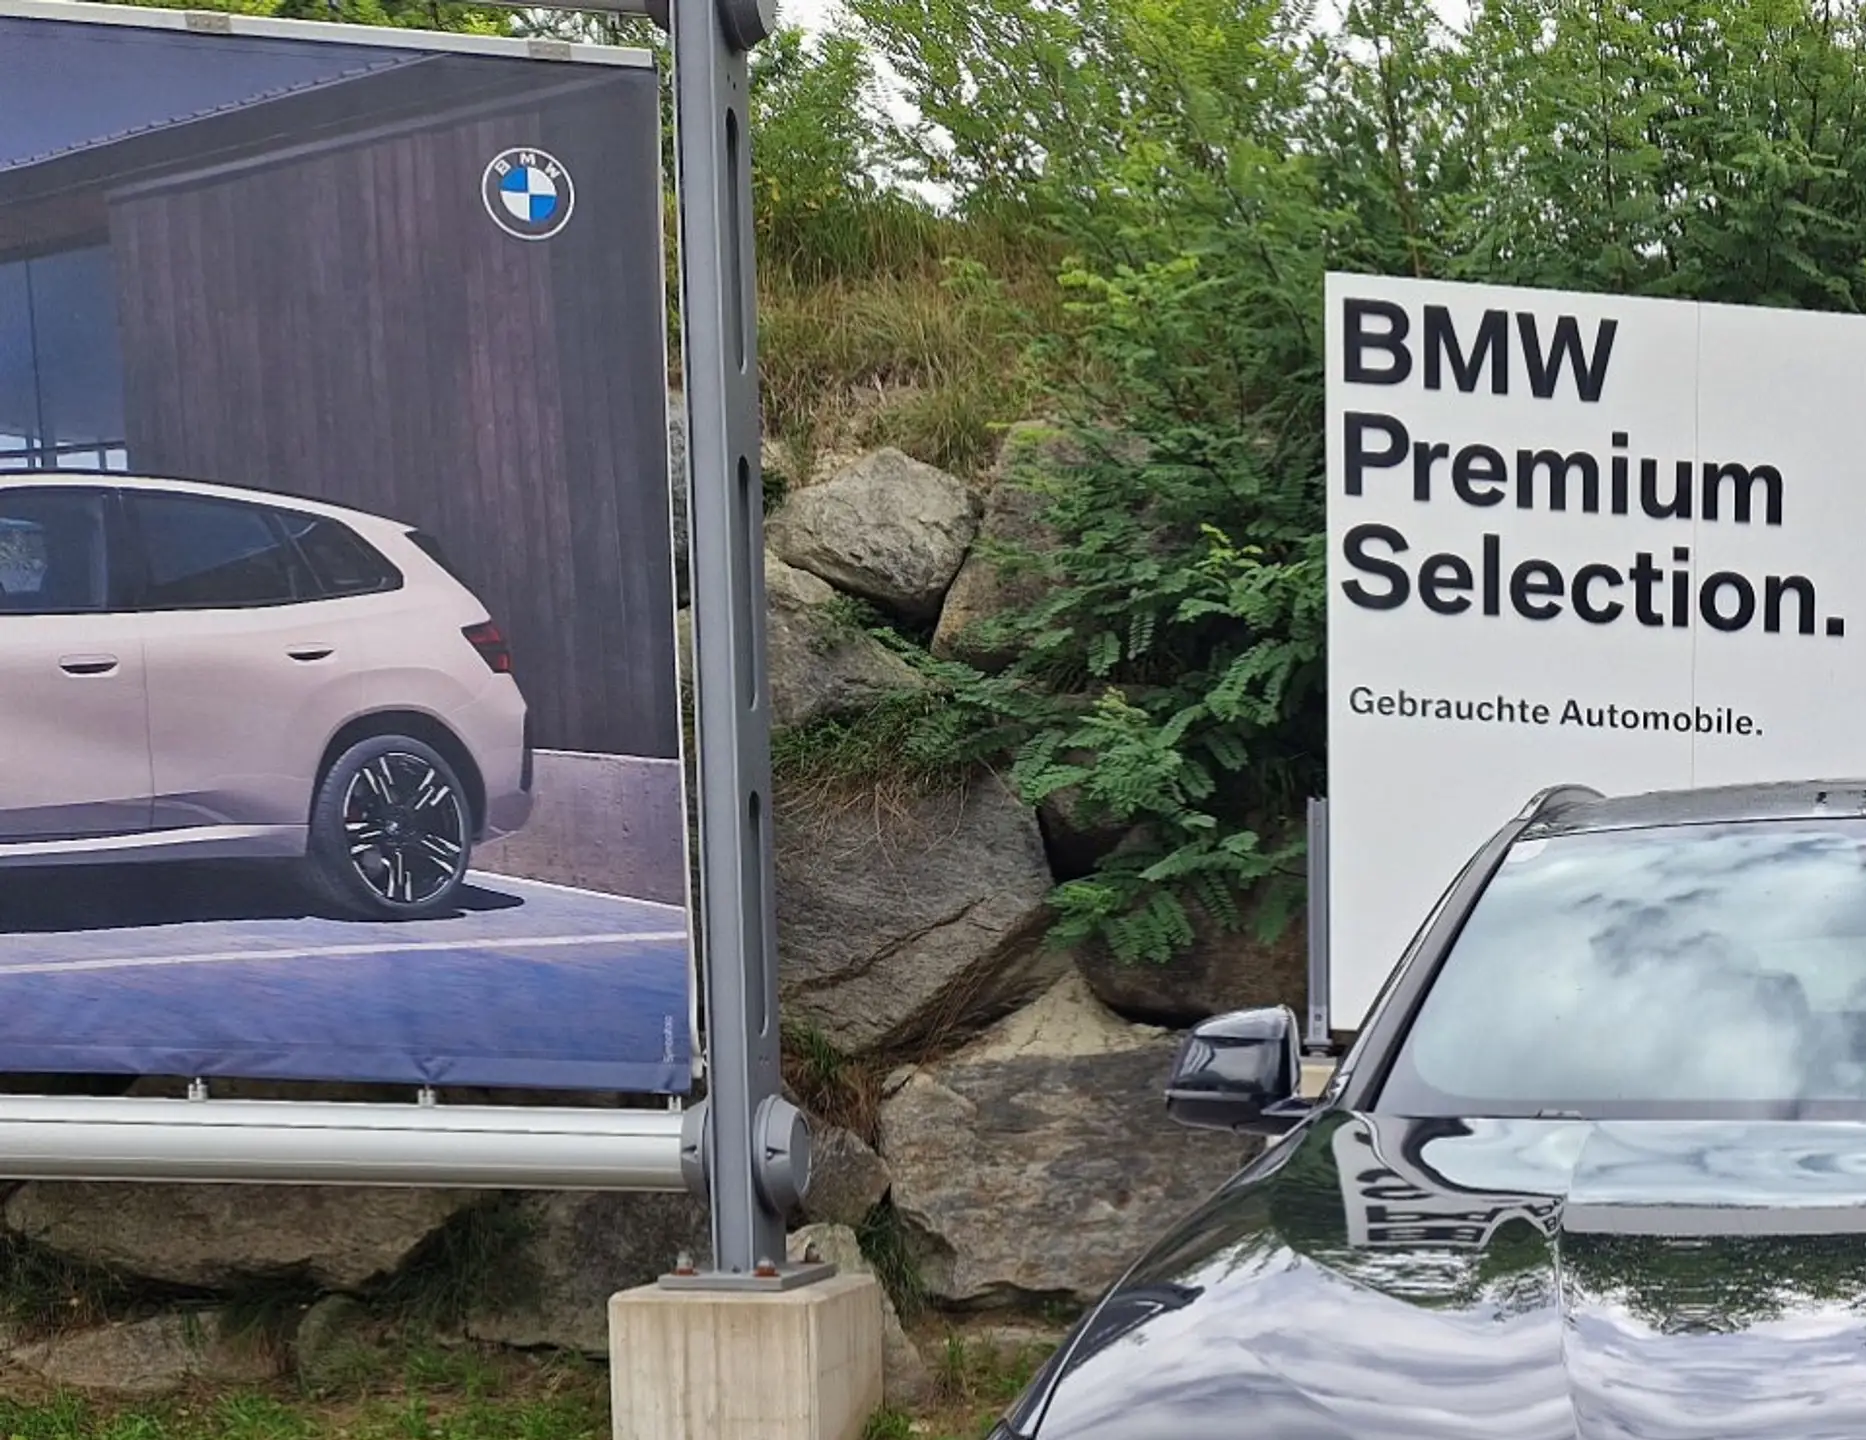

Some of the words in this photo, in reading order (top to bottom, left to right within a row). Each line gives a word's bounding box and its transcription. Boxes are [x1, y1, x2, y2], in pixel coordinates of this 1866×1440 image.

[494, 152, 560, 178] BMW
[1343, 298, 1619, 403] BMW
[1344, 411, 1783, 526] Premium
[1341, 523, 1845, 638] Selection.
[1349, 686, 1550, 727] Gebrauchte
[1559, 699, 1763, 737] Automobile.
